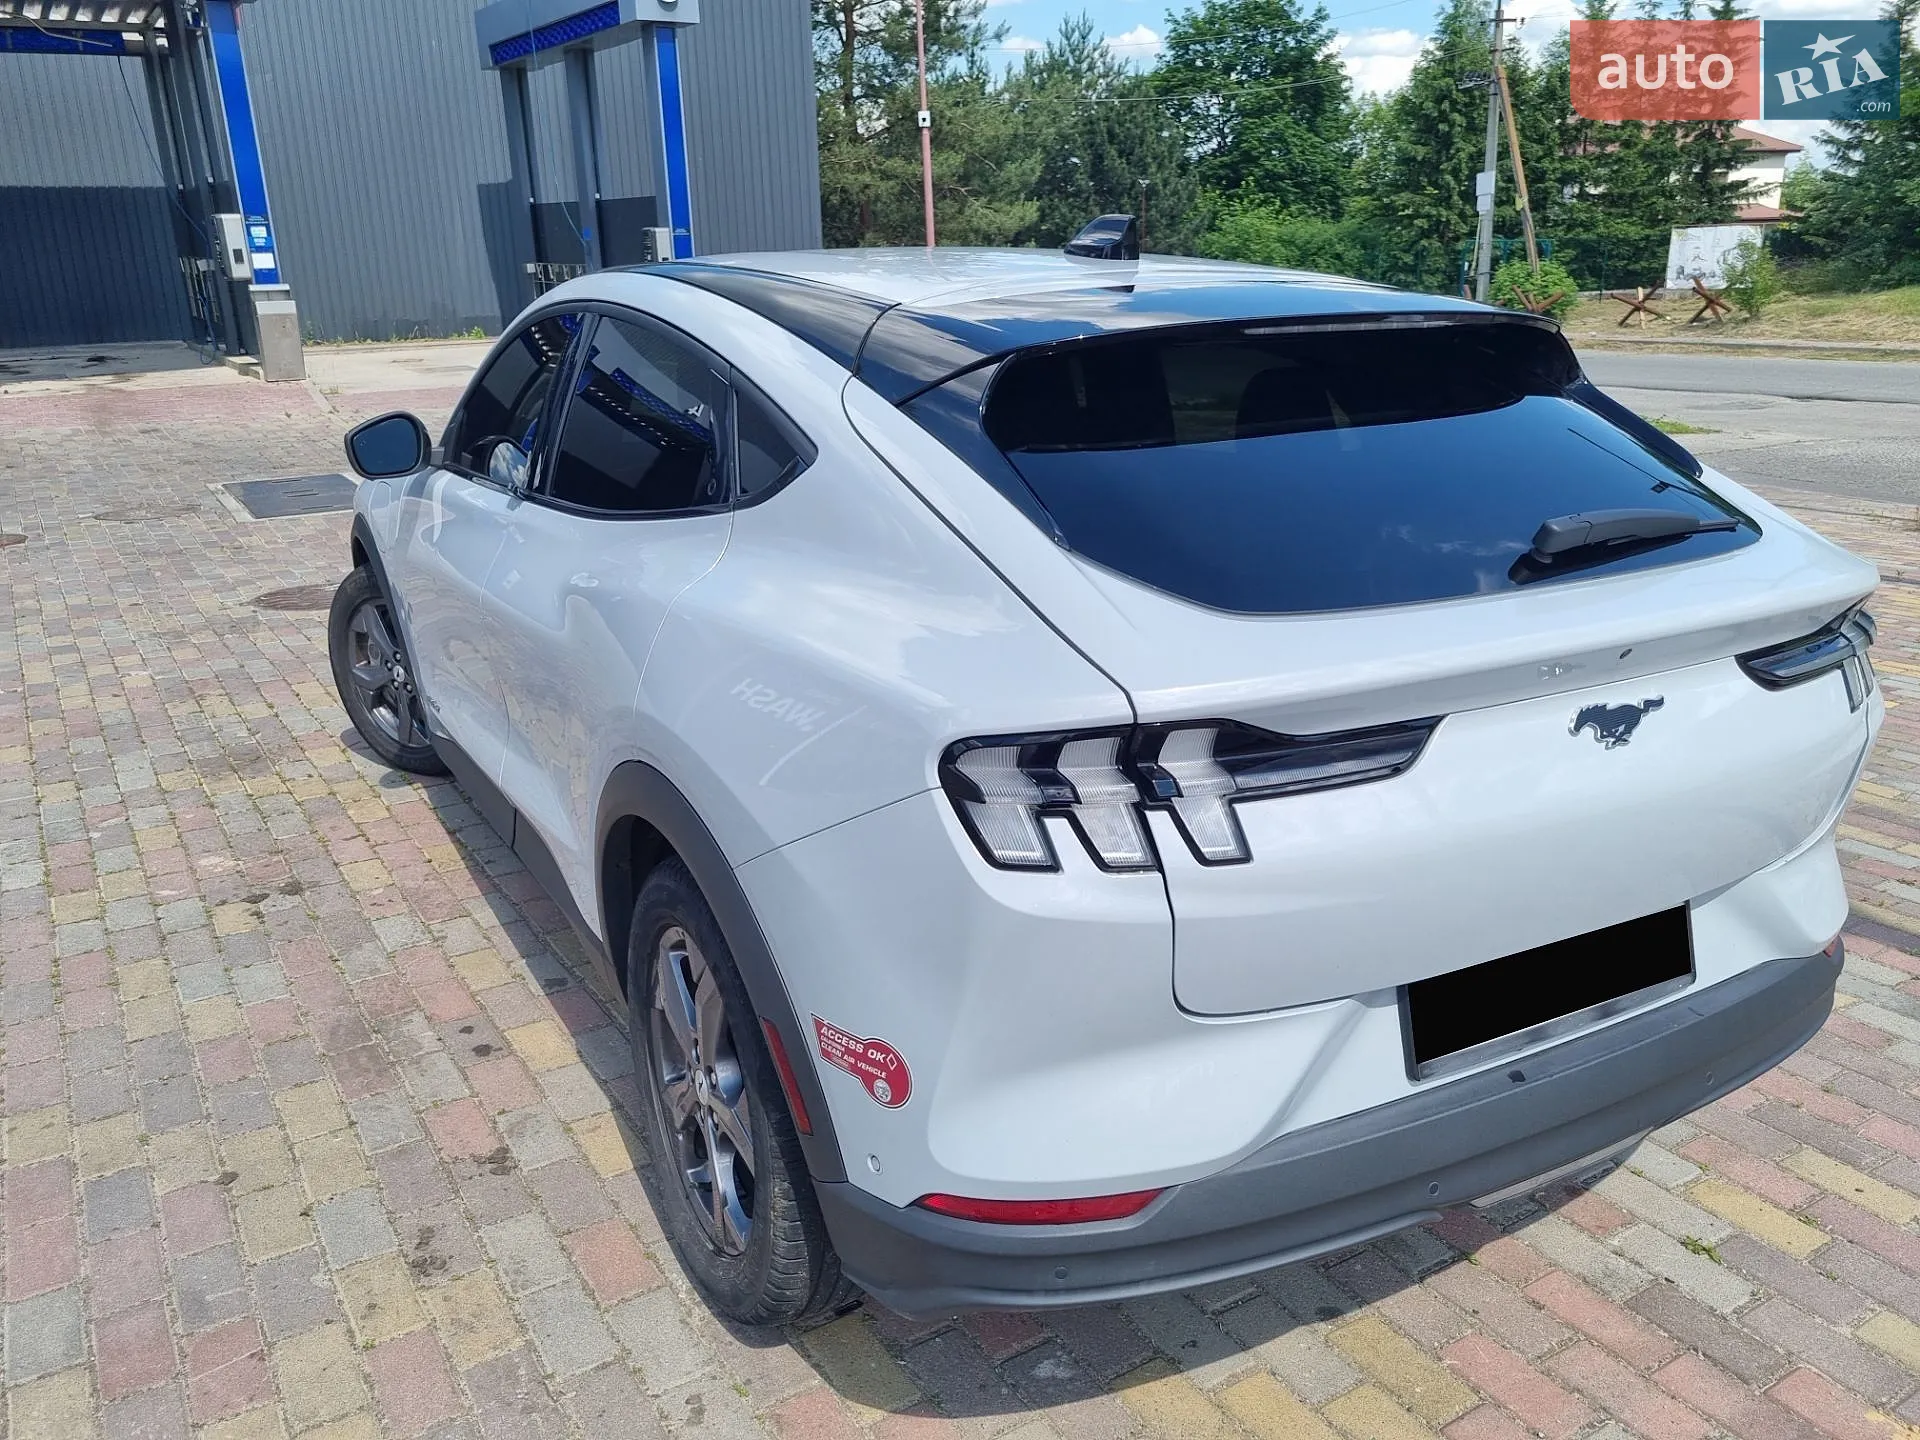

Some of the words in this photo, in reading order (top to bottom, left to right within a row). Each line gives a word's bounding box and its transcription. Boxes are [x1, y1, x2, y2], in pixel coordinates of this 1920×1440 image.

[821, 1026, 864, 1053] ACCESS
[867, 1049, 886, 1063] OK
[821, 1041, 841, 1057] CLEAN
[843, 1054, 855, 1064] AIR
[857, 1060, 887, 1078] VEHICLE
